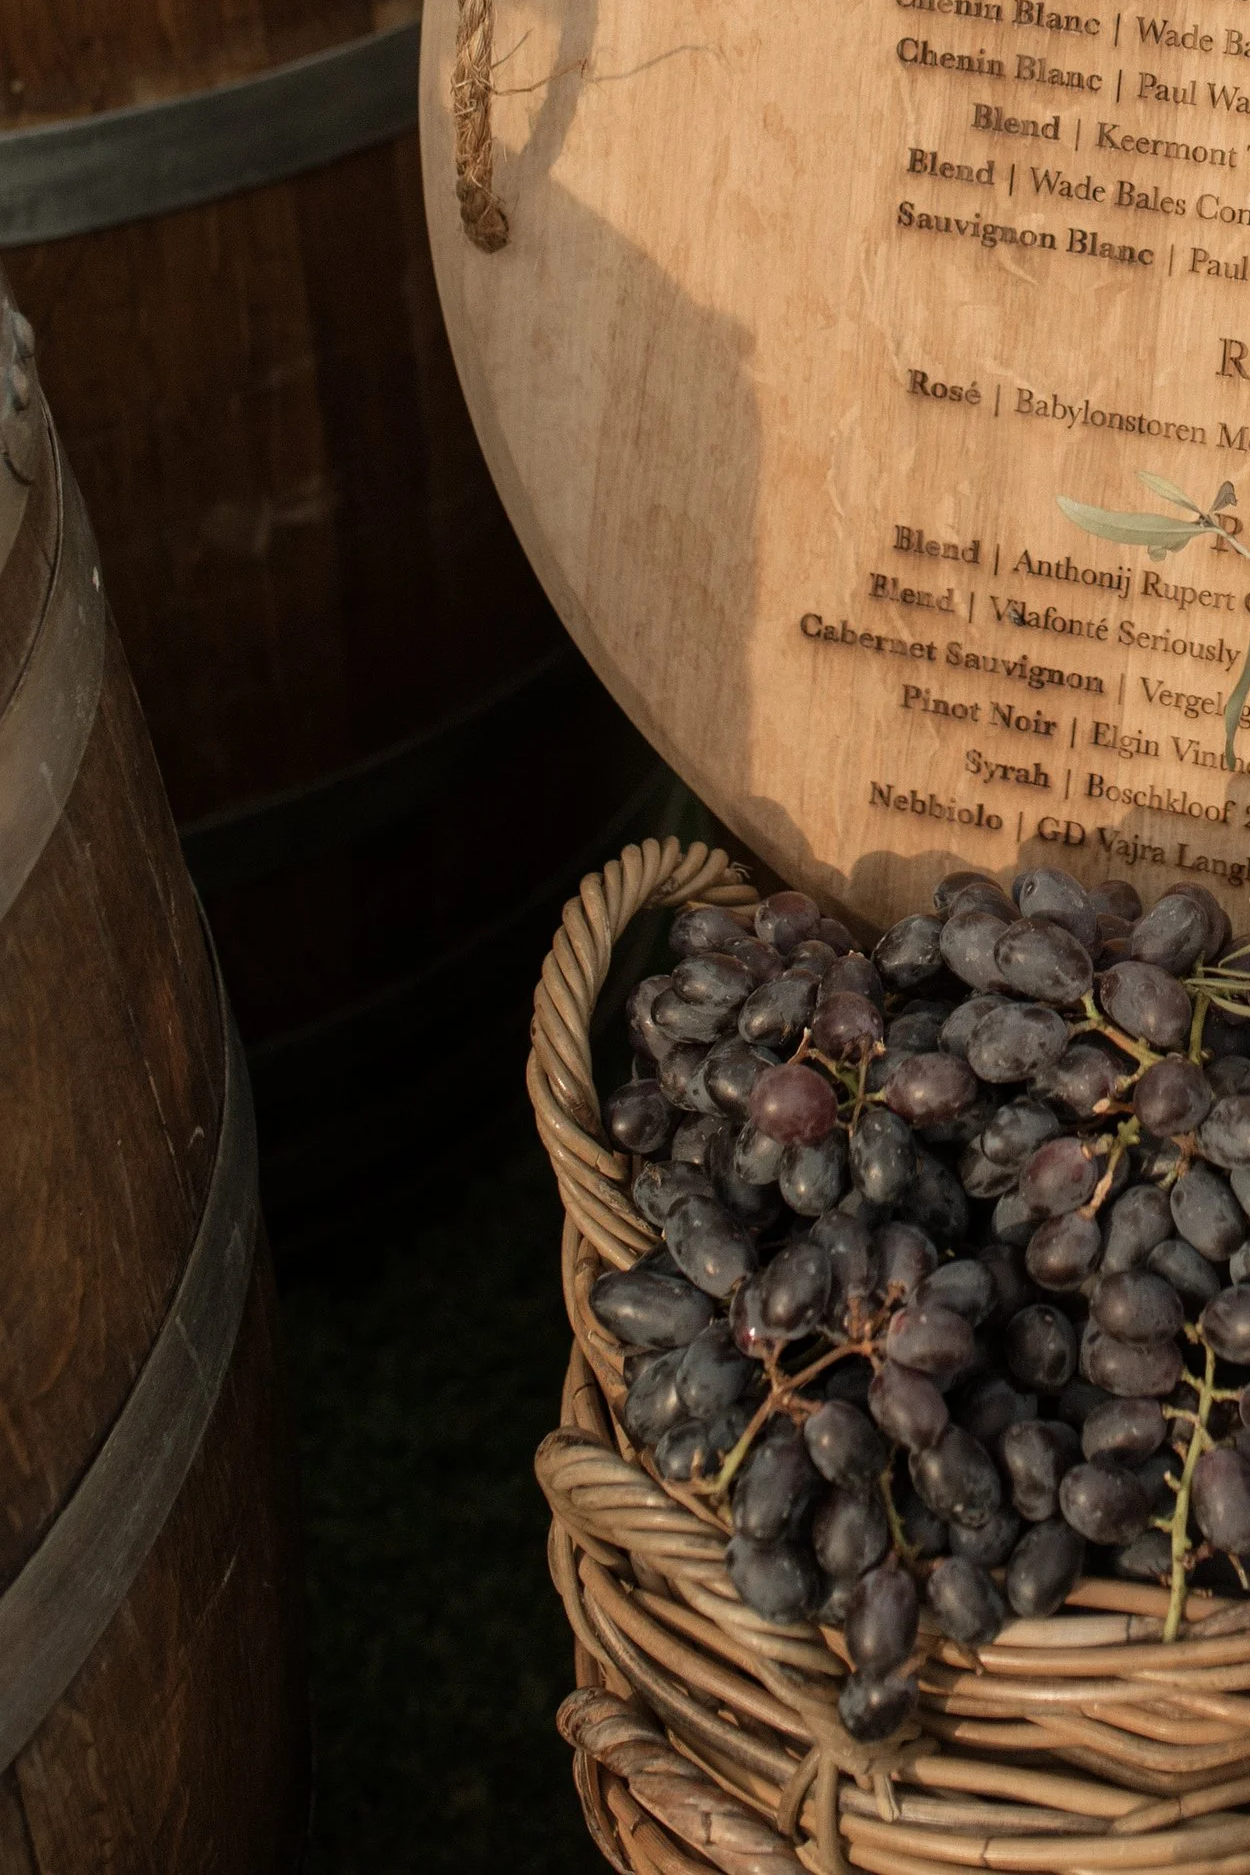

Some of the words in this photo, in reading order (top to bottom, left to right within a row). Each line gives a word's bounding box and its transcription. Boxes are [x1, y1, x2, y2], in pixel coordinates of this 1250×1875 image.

[1012, 0, 1100, 35] Blanc
[1137, 17, 1213, 53] Wade
[897, 38, 1005, 78] Chenin
[1015, 54, 1102, 92] Blanc
[1138, 73, 1198, 106] Paul
[972, 103, 1060, 141] Blend
[1095, 123, 1237, 168] Keermont
[907, 148, 995, 186] Blend
[1030, 167, 1105, 203] Wade
[1114, 181, 1186, 216] Bales
[897, 202, 1057, 250] Sauvignon
[1066, 229, 1154, 266] Blanc
[1189, 248, 1248, 282] Paul
[907, 370, 981, 405] Rosé
[1014, 389, 1206, 445] Babylonstoren
[892, 526, 980, 564] Blend
[1013, 550, 1131, 598] Anthonij
[1140, 571, 1235, 612] Rupert
[800, 614, 937, 661] Cabernet
[946, 643, 1104, 693] Sauvignon
[869, 573, 954, 612] Blend
[990, 596, 1108, 641] Vlafonté
[1119, 621, 1241, 671] Seriously
[901, 684, 979, 723] Pinot
[990, 701, 1058, 736] Noir
[1091, 721, 1160, 760] Elgin
[869, 782, 1003, 830] Nebbiolo
[1038, 816, 1086, 846] GD
[1097, 827, 1167, 865] Vajra
[965, 749, 1050, 789] Syrah
[1085, 773, 1236, 825] Boschkloof
